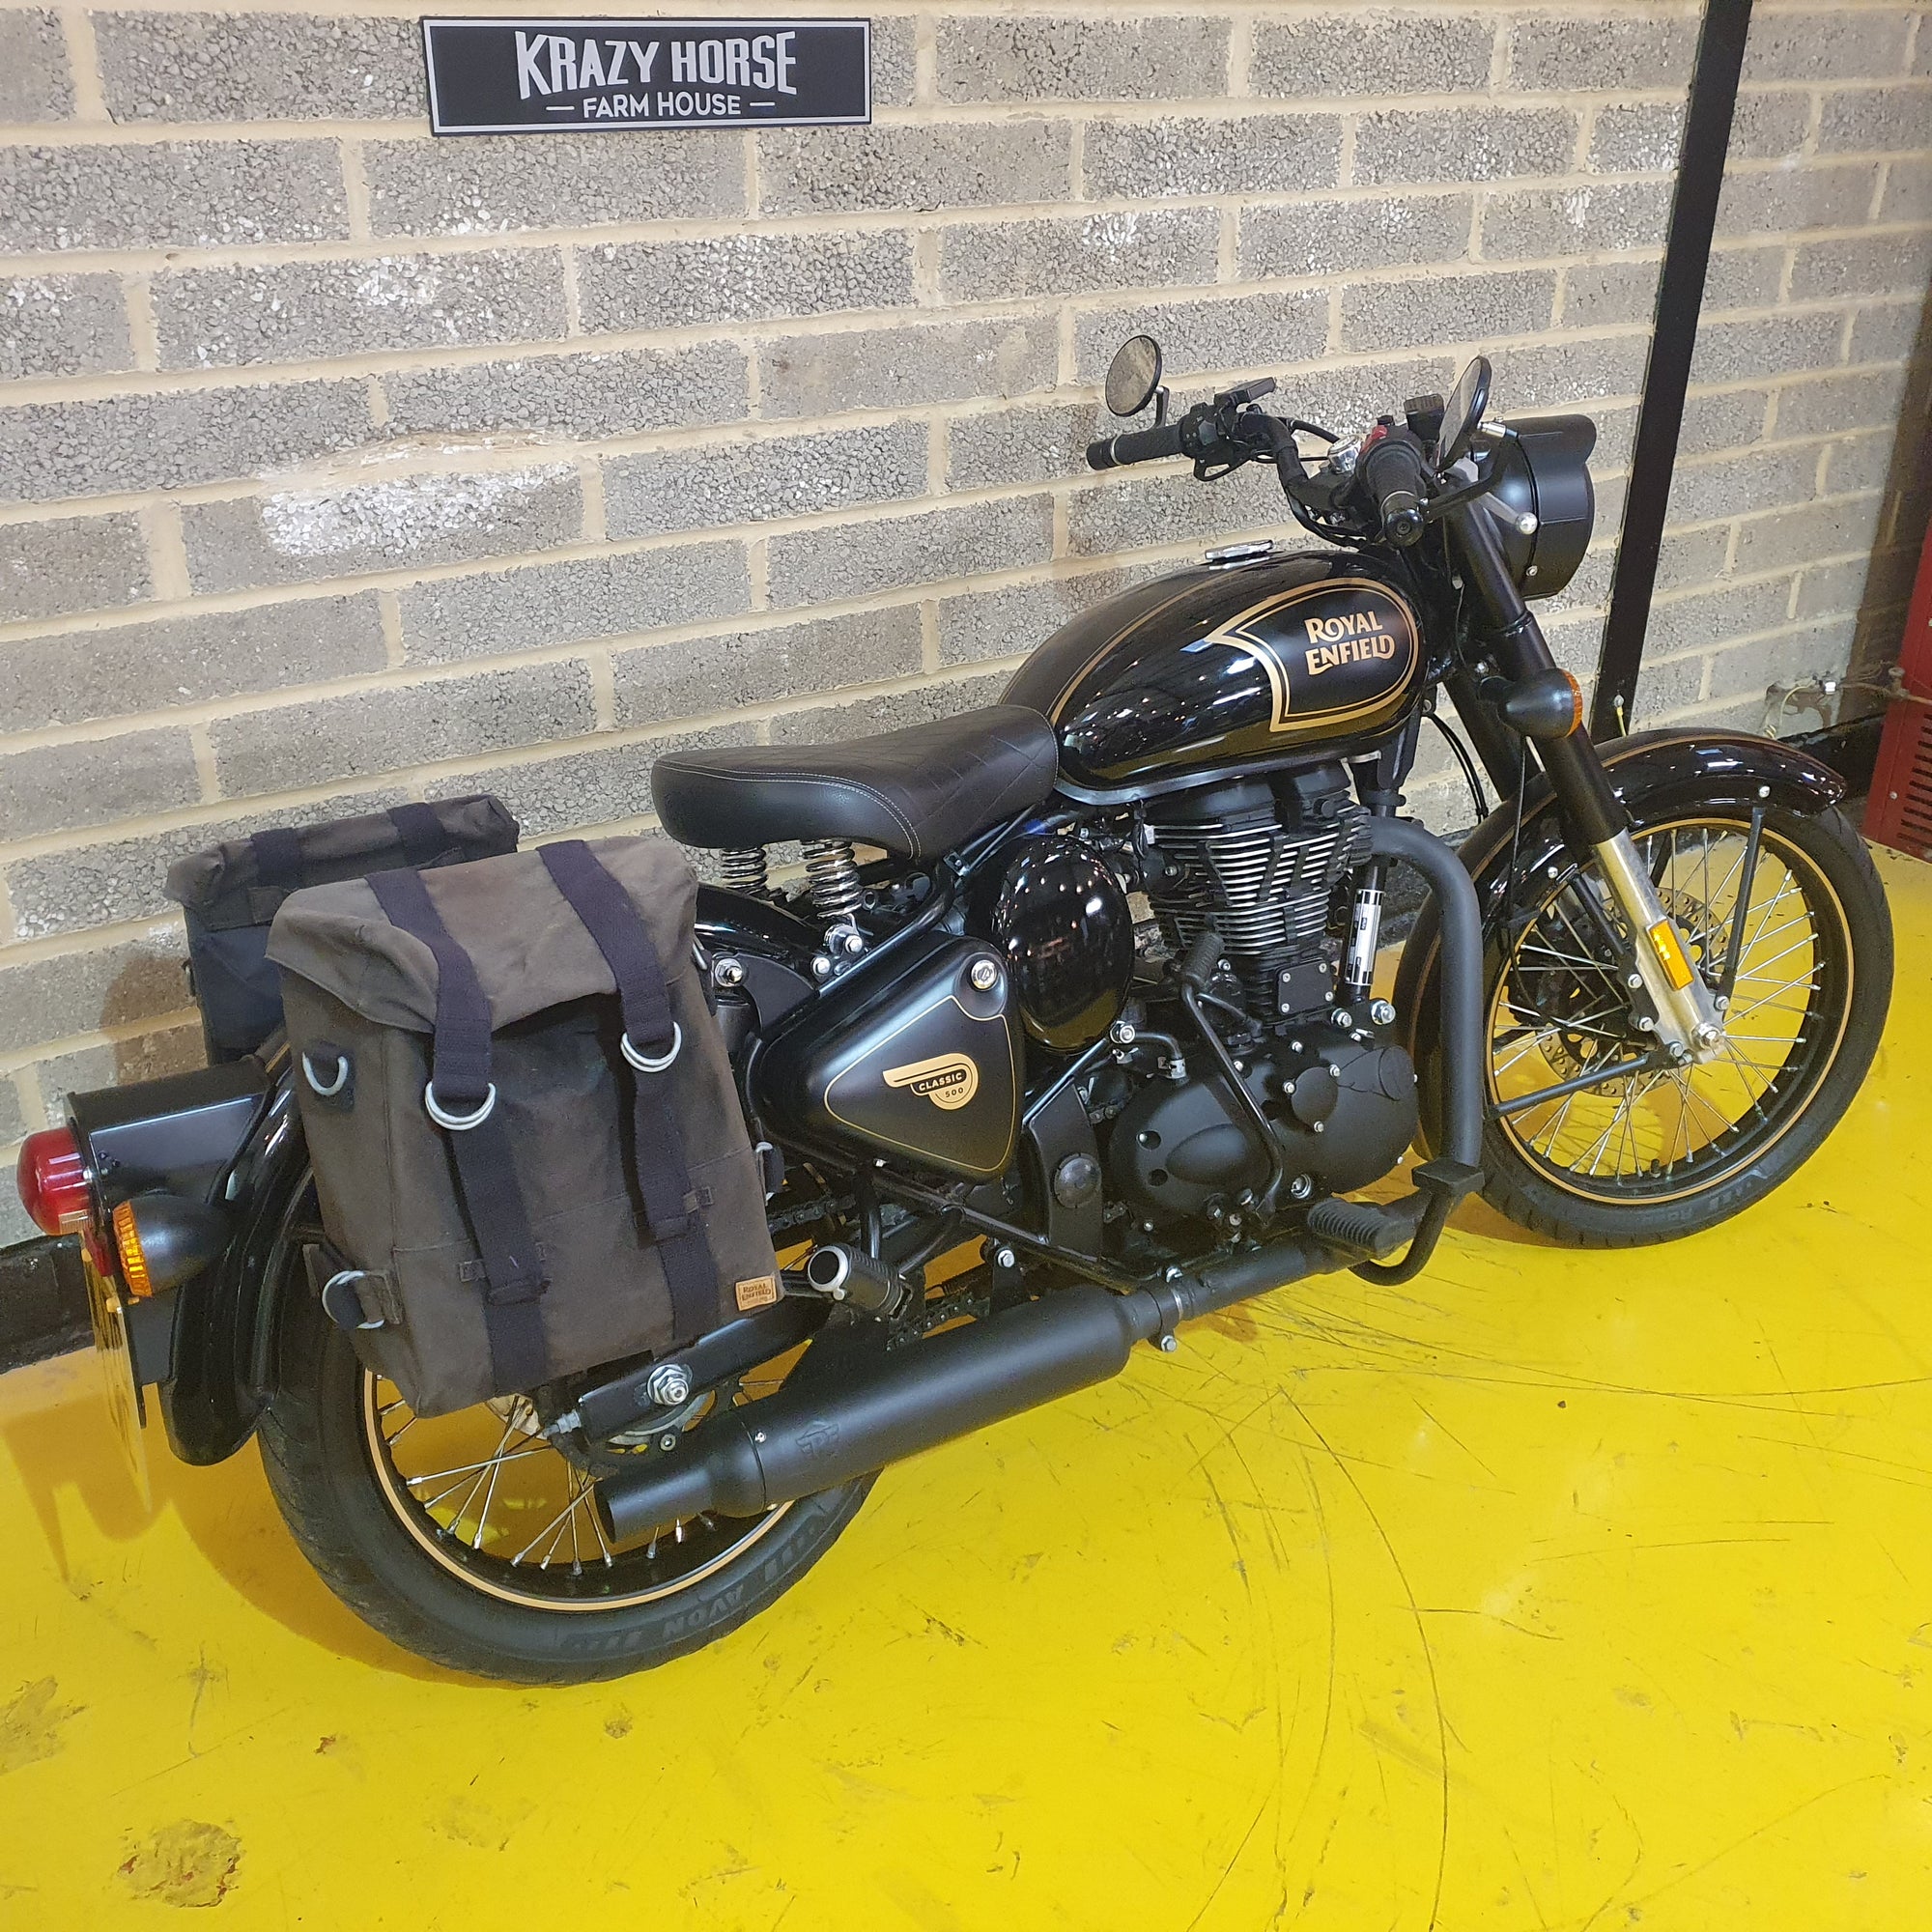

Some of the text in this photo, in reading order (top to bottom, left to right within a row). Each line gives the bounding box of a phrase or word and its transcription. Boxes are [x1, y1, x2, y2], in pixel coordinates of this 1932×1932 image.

[514, 31, 797, 99] KRAZY HORSE
[582, 91, 741, 118] FARM HOUSE
[1304, 611, 1382, 644] ROYAL
[1305, 634, 1395, 675] ENFIELD
[918, 1071, 963, 1092] CLASSIC
[945, 1087, 964, 1098] 500
[743, 1283, 767, 1293] ROYAL
[663, 1584, 744, 1642] AVON
